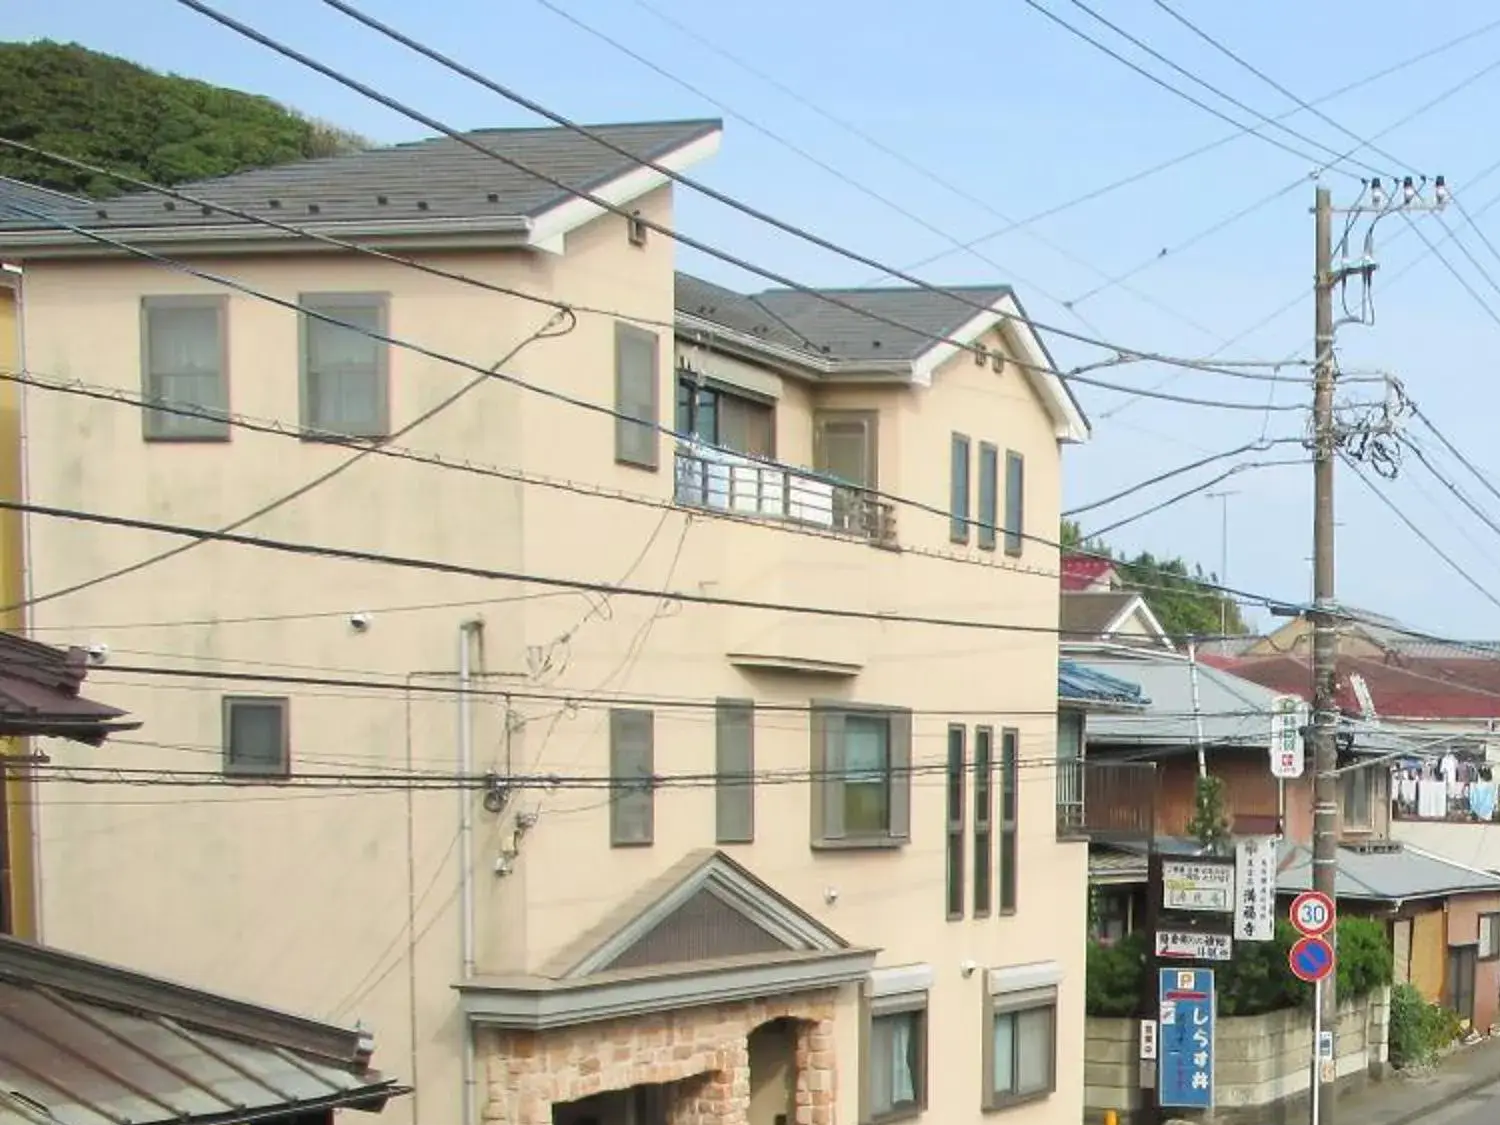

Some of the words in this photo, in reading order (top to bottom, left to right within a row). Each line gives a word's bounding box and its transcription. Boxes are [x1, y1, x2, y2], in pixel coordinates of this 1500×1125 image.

[1301, 905, 1325, 924] 30
[1193, 1007, 1208, 1089] しらす丼
